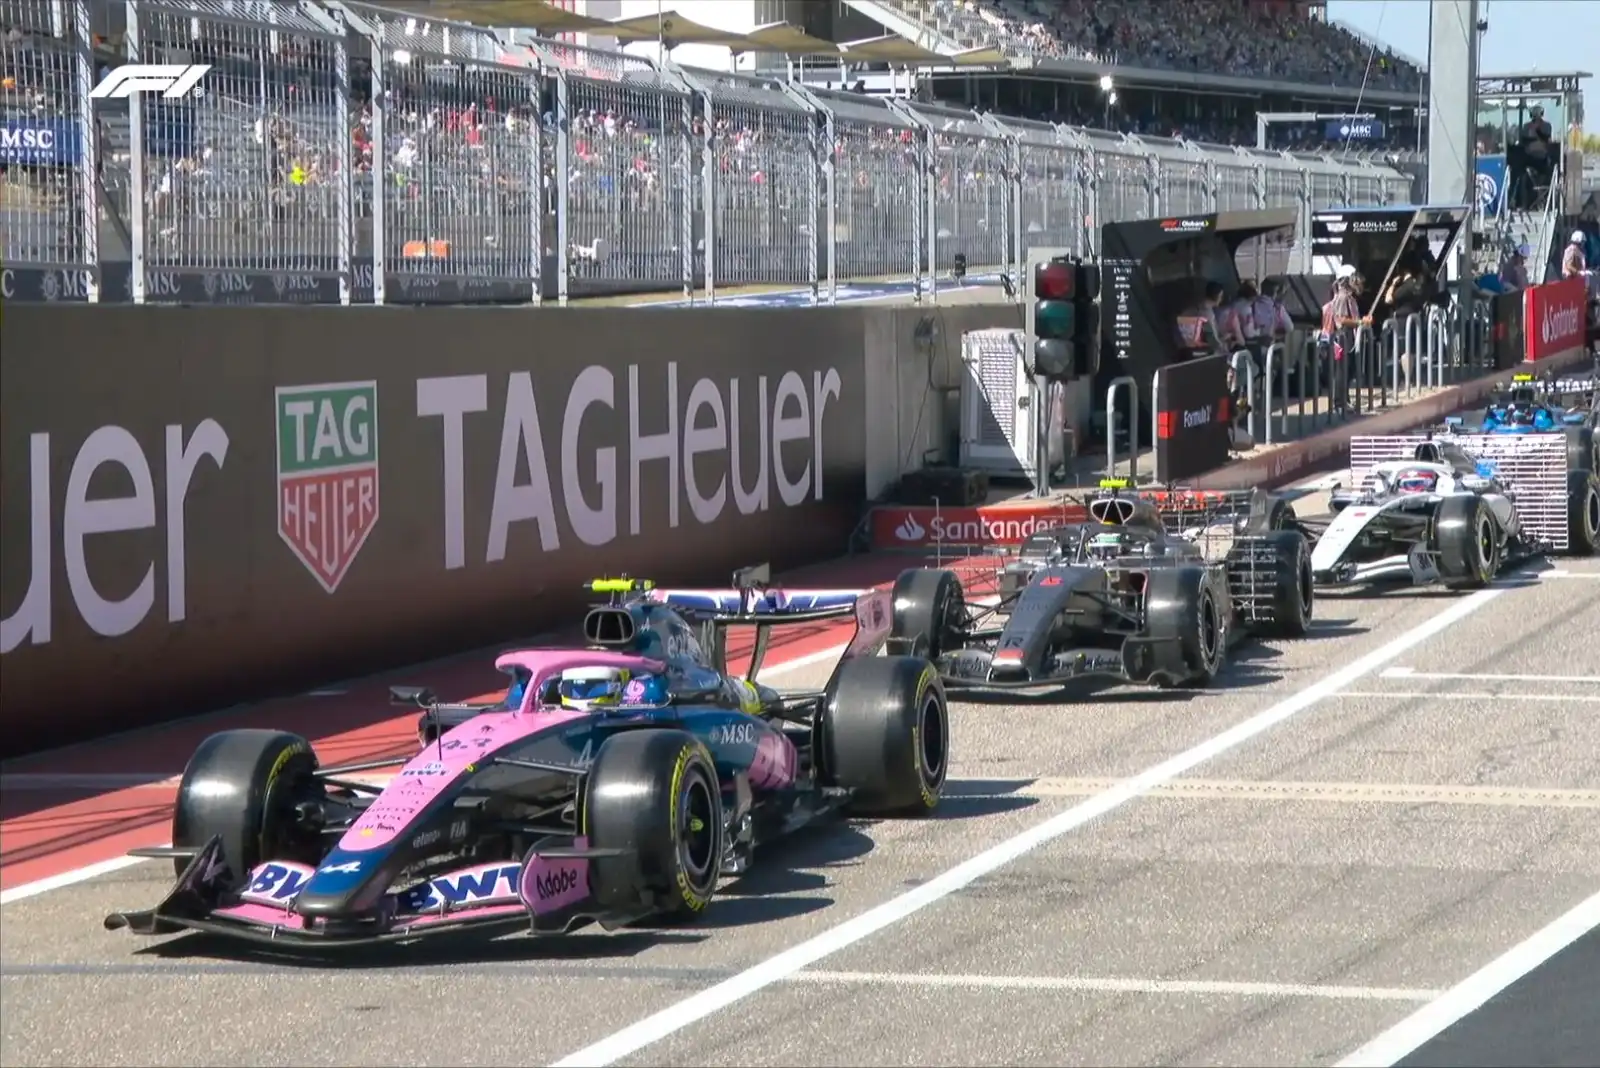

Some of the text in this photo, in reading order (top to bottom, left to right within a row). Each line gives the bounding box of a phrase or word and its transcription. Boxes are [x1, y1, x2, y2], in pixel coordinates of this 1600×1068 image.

[0, 128, 53, 149] MSC
[1352, 220, 1398, 228] CADILLAC
[62, 269, 88, 297] MS
[353, 264, 374, 289] MS
[284, 395, 370, 463] TAG
[283, 475, 374, 577] HEUER
[720, 723, 755, 745] MSC
[450, 820, 468, 839] FIA
[400, 865, 522, 910] BWT
[536, 867, 578, 900] Adobe
